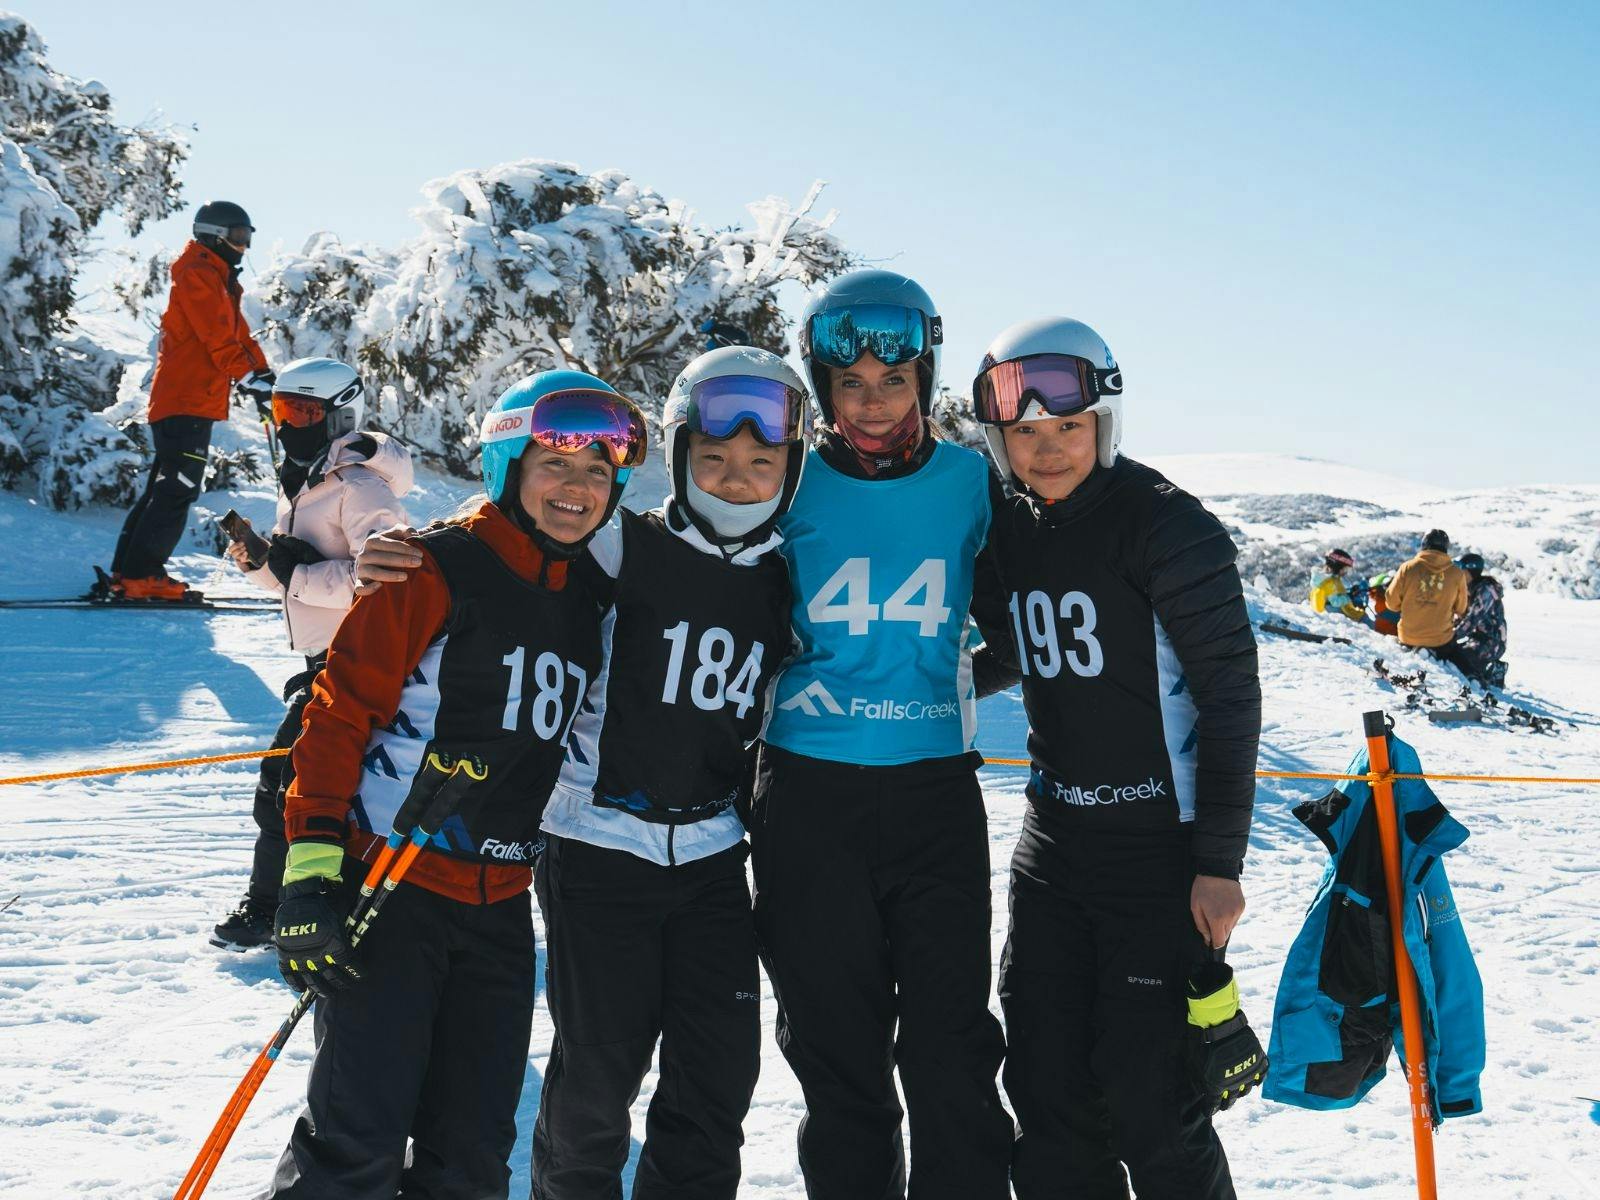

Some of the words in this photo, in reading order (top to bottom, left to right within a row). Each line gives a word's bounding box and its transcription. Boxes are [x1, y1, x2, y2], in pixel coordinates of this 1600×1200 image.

[807, 557, 952, 638] 44
[1008, 590, 1104, 679] 193
[661, 620, 765, 720] 184
[502, 645, 587, 748] 187
[850, 697, 958, 720] FallsCreek
[1054, 777, 1166, 806] FallsCreek
[280, 922, 317, 937] LEKI
[1127, 976, 1162, 986] SPYDER
[1224, 1053, 1257, 1079] LEKI
